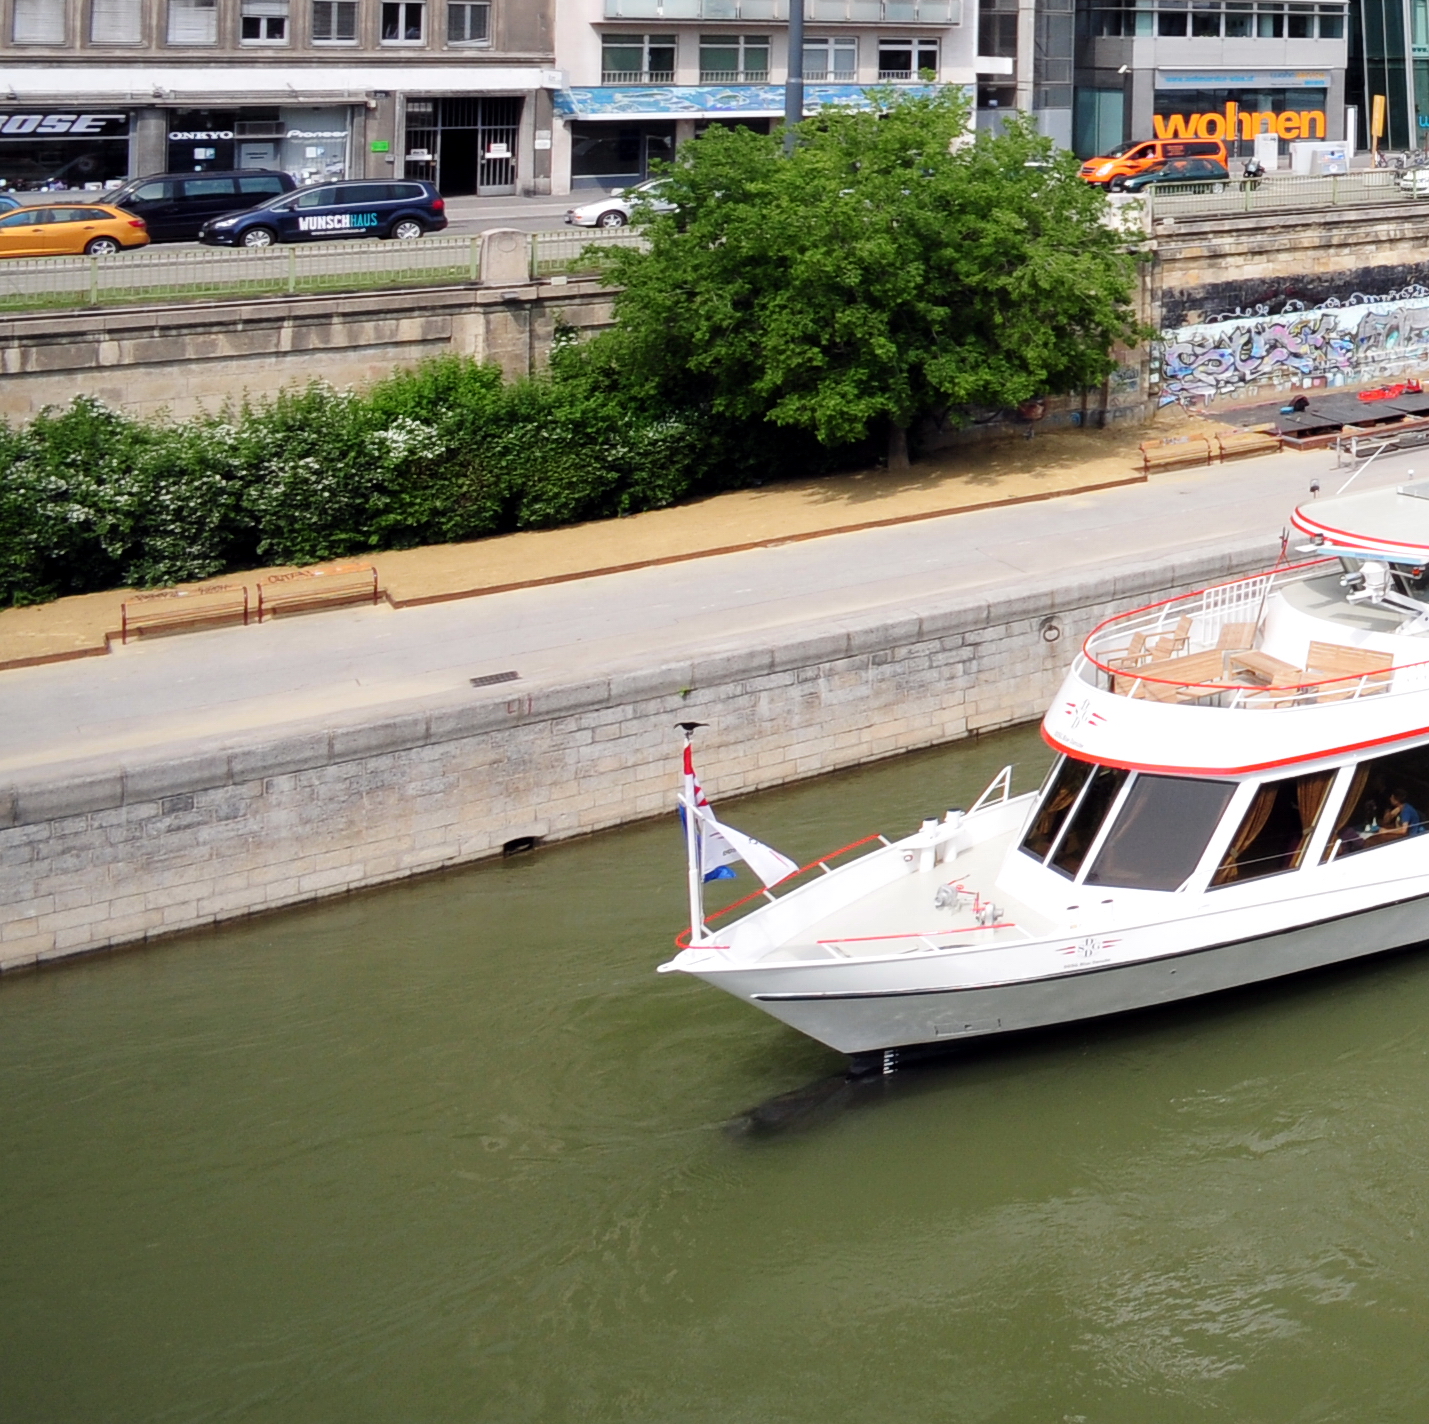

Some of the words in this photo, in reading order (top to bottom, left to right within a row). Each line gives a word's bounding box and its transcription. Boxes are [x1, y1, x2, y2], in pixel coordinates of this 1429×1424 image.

[0, 114, 126, 133] OSE
[1153, 101, 1327, 141] wohnen
[169, 131, 234, 141] ONKYO
[286, 129, 349, 139] Pioneer
[298, 213, 378, 231] WUNSCHHAUS
